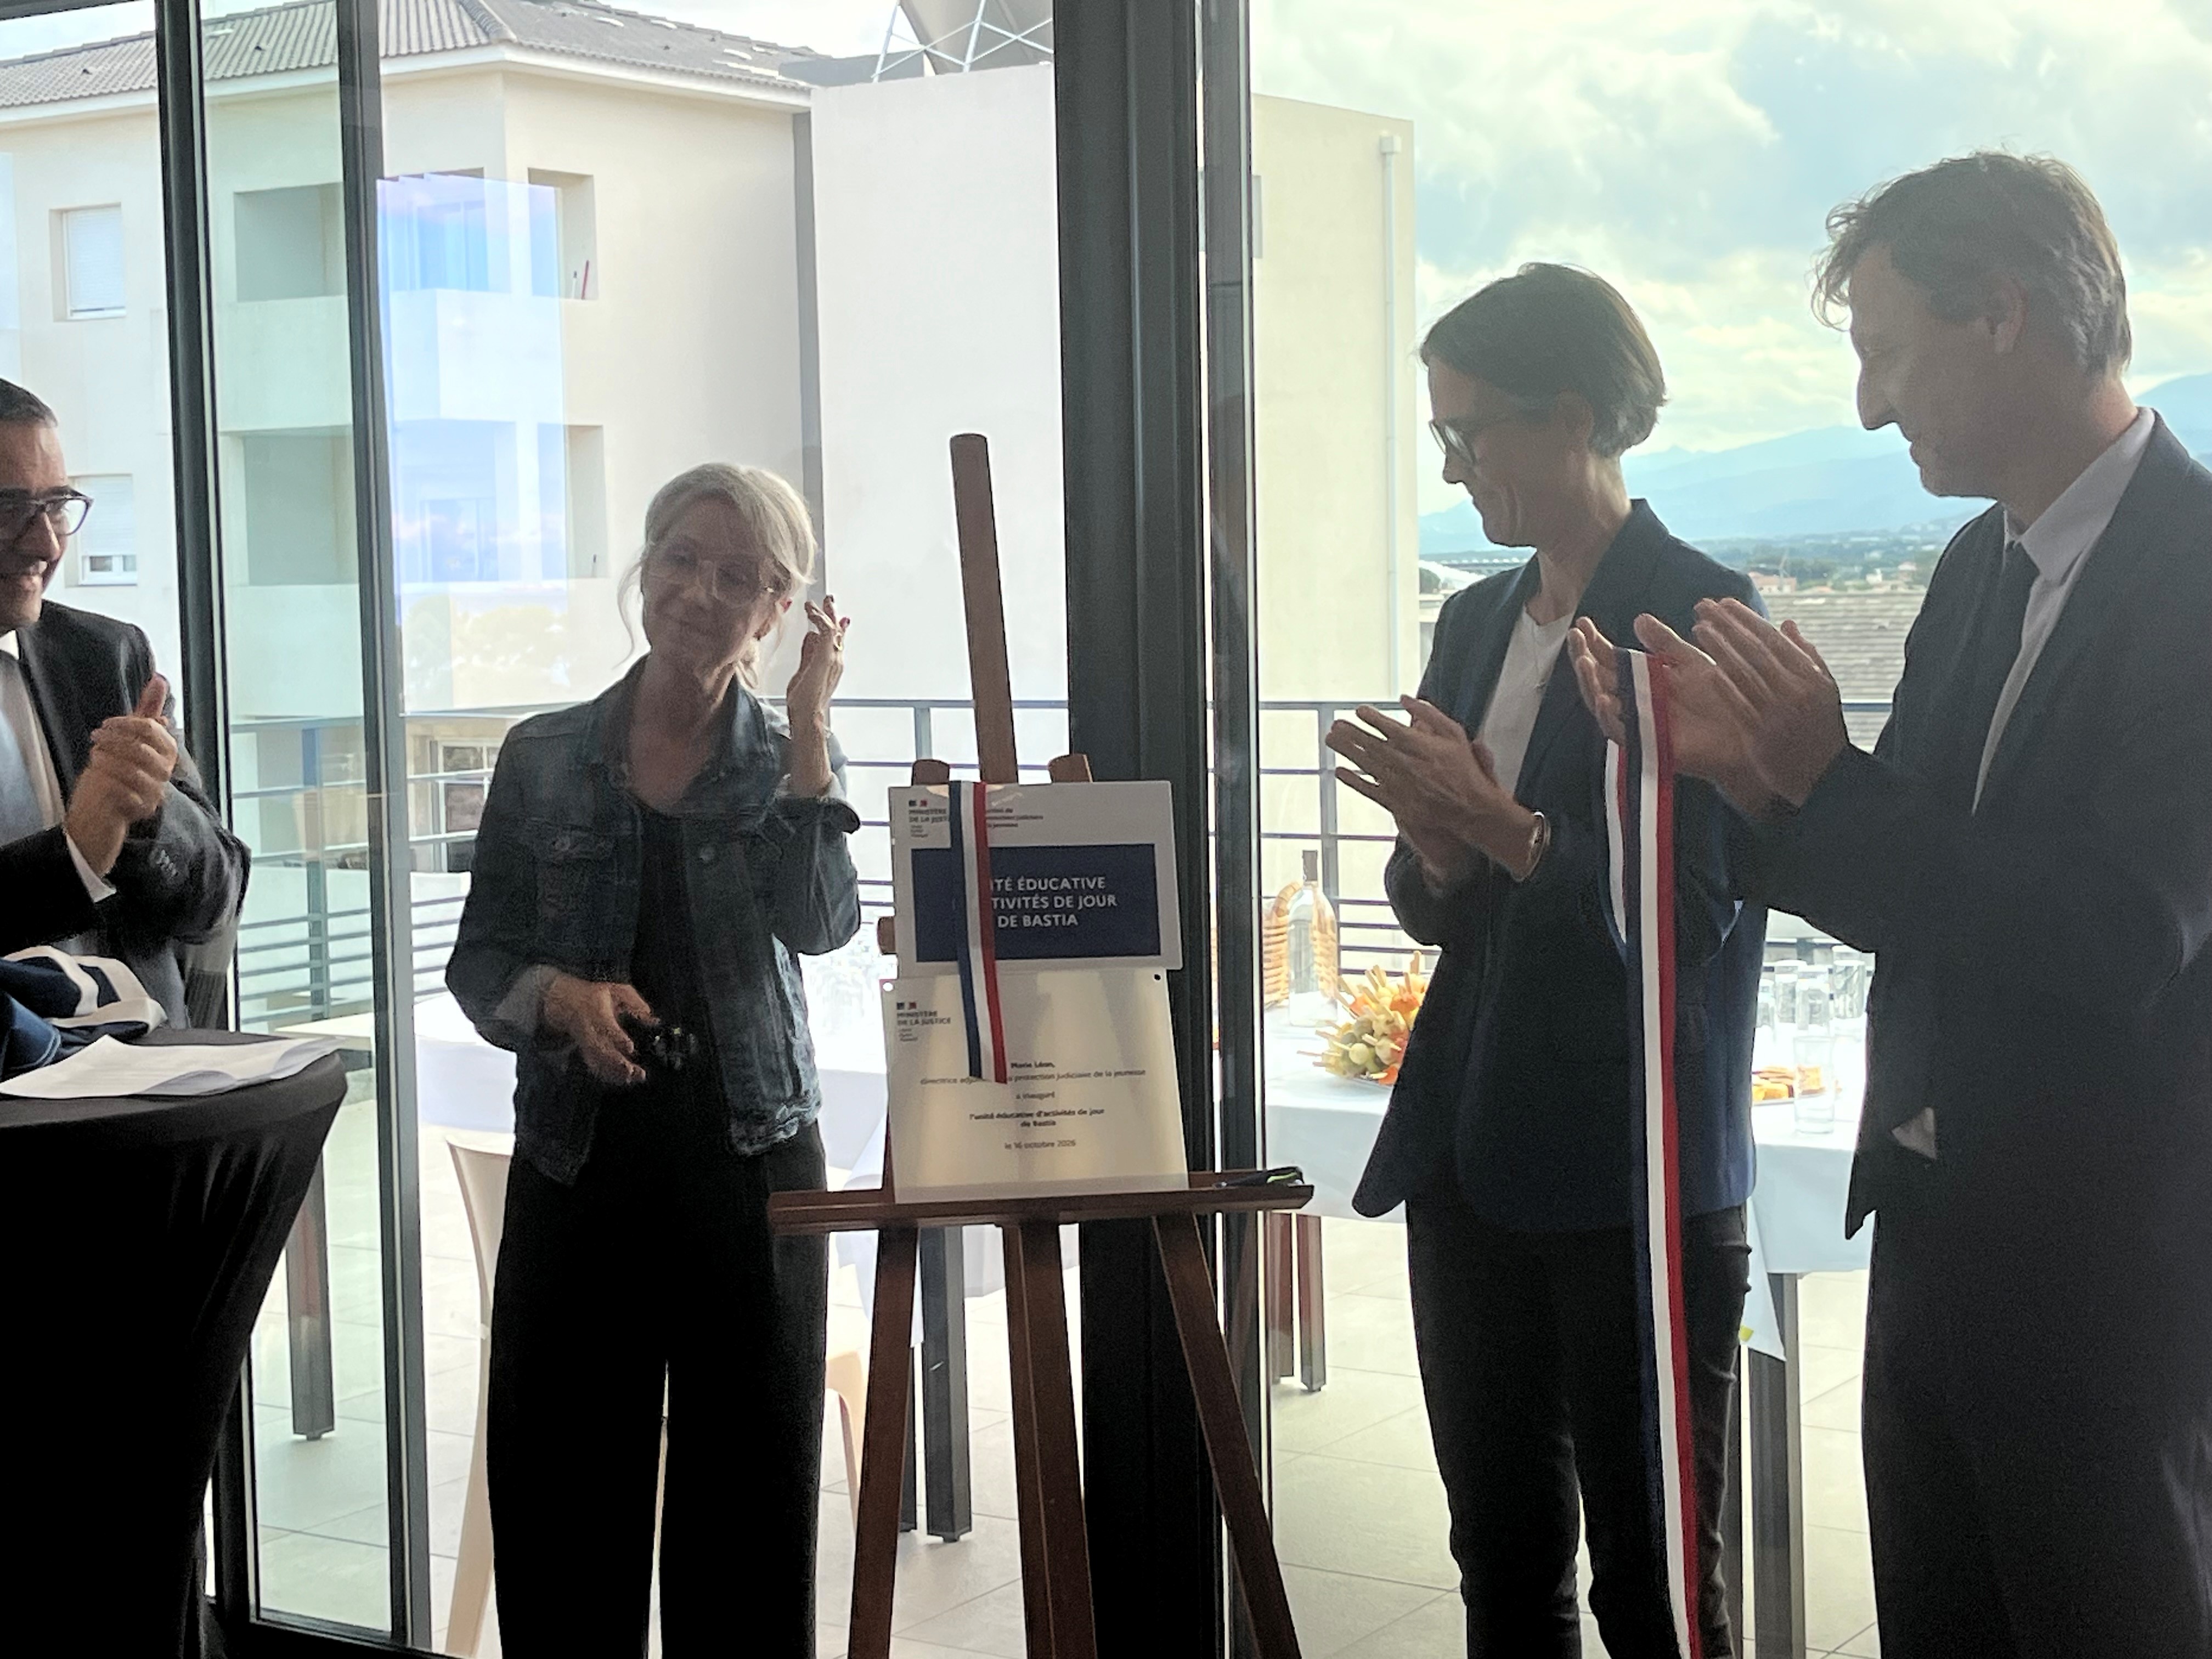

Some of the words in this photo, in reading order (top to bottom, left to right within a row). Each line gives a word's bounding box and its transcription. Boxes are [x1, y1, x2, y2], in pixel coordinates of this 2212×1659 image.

[990, 877, 1013, 891] ITÉ
[1017, 877, 1106, 891] ÉDUCATIVE
[991, 894, 1049, 910] TIVITÉS
[1053, 896, 1074, 909] DE
[1077, 894, 1118, 911] JOUR
[997, 915, 1018, 928] DE
[1022, 913, 1079, 928] BASTIA
[1014, 1073, 1055, 1082] protection
[1056, 1071, 1091, 1081] judiciaire
